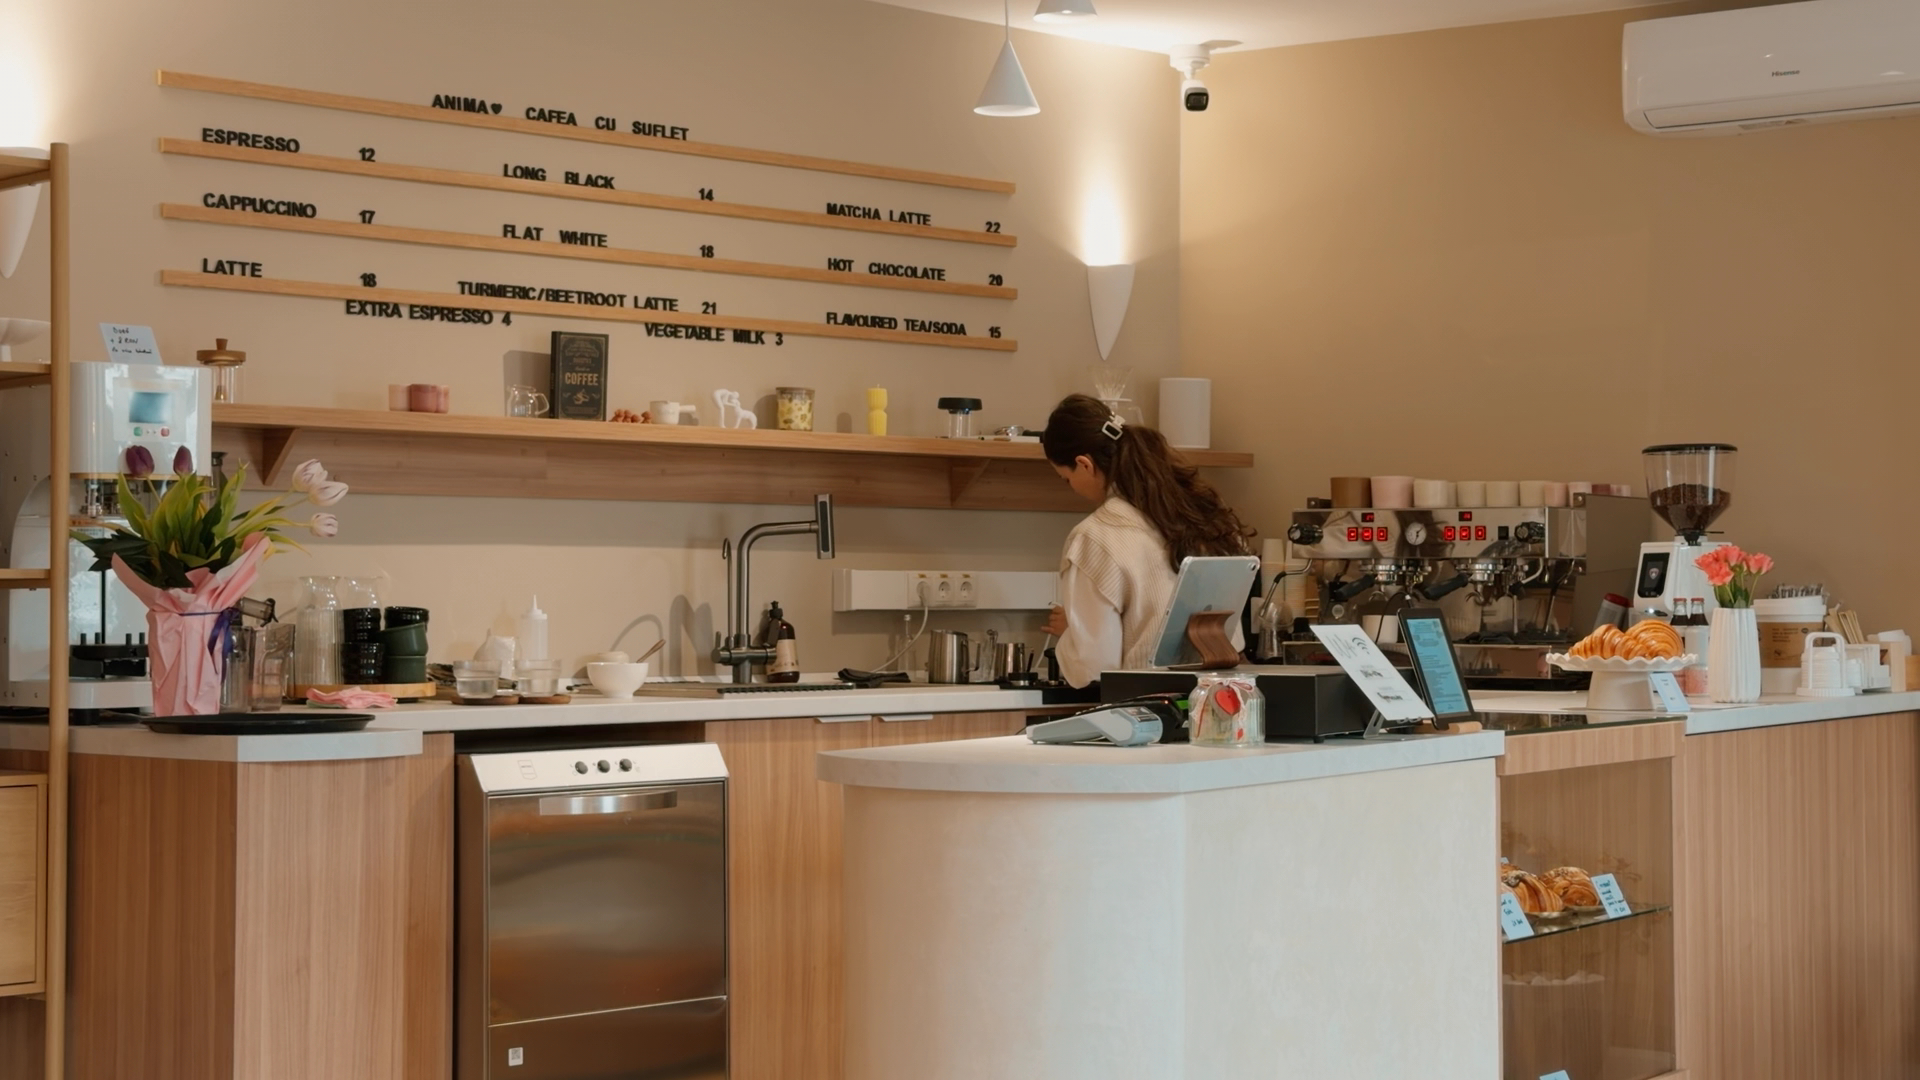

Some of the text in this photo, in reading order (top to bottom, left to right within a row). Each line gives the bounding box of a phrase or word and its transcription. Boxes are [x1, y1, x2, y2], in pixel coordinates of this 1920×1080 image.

[432, 95, 689, 141] ANIMA CAFEA CU SUFLET
[203, 128, 375, 162] ESPRESSO 12
[504, 164, 713, 201] LONG BLACK 14
[203, 193, 375, 224] CAPPUCCINO 17
[827, 203, 1001, 234] MATCHA LATTE 22
[503, 224, 714, 258] FLAT WHITE 18
[203, 258, 376, 287] LATTE 18
[828, 258, 1003, 286] HOT CHOCOLATE 20
[345, 299, 511, 325] EXTRA ESPRESSO 4
[458, 281, 716, 314] TURMERIC/BEETROOT LATTE 21
[644, 322, 783, 345] VEGETABLE MILK 3
[827, 312, 1001, 338] FLAVOURED TEA/SODA 15
[565, 372, 599, 386] COFFEE
